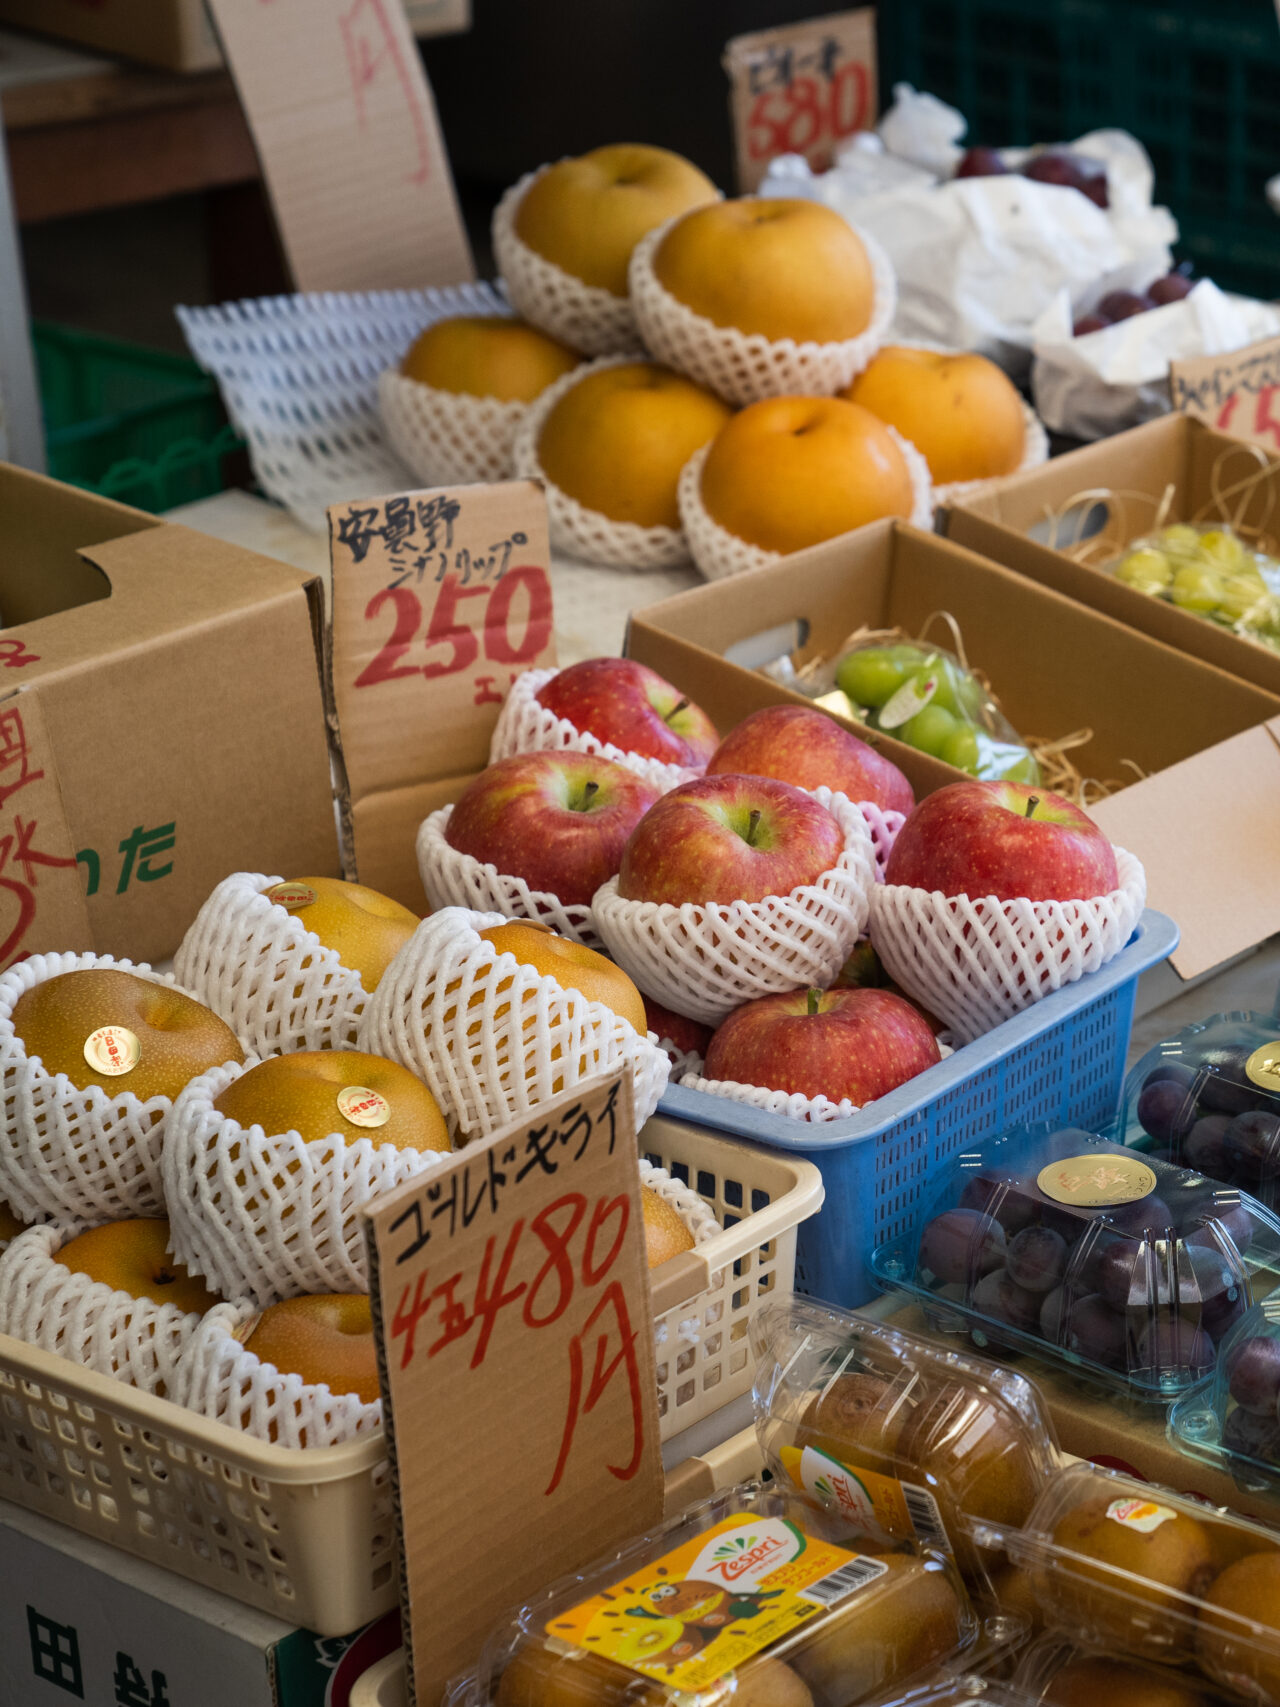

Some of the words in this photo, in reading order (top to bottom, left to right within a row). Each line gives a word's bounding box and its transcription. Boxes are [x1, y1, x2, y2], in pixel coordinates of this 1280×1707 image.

[749, 61, 869, 161] 680
[337, 496, 461, 563] 安曇野
[352, 565, 554, 689] 250
[707, 1535, 789, 1582] Zespri
